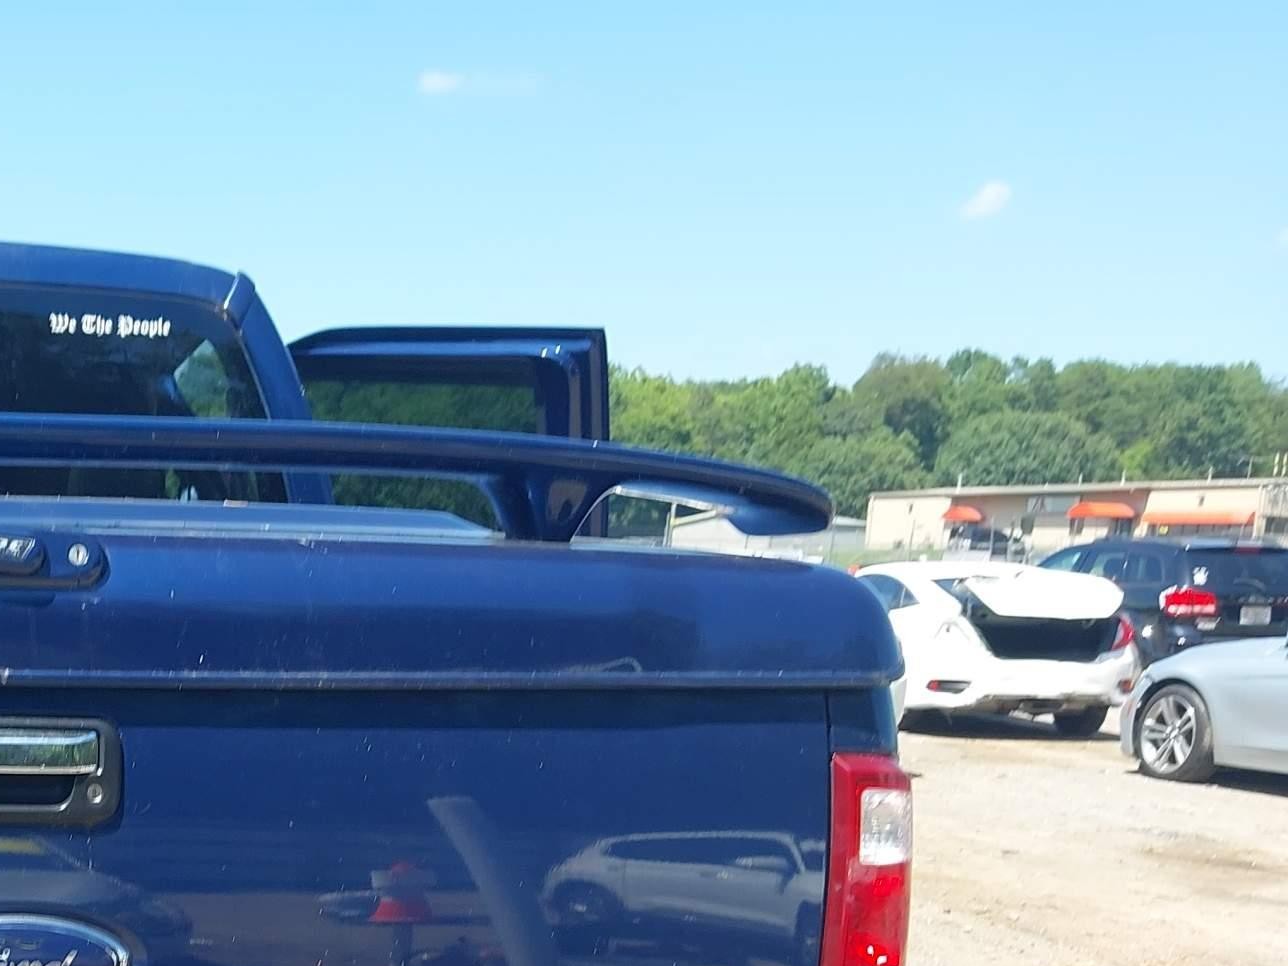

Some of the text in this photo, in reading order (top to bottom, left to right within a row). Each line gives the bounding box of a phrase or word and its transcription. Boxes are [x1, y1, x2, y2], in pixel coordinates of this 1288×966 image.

[49, 312, 171, 339] We The People
